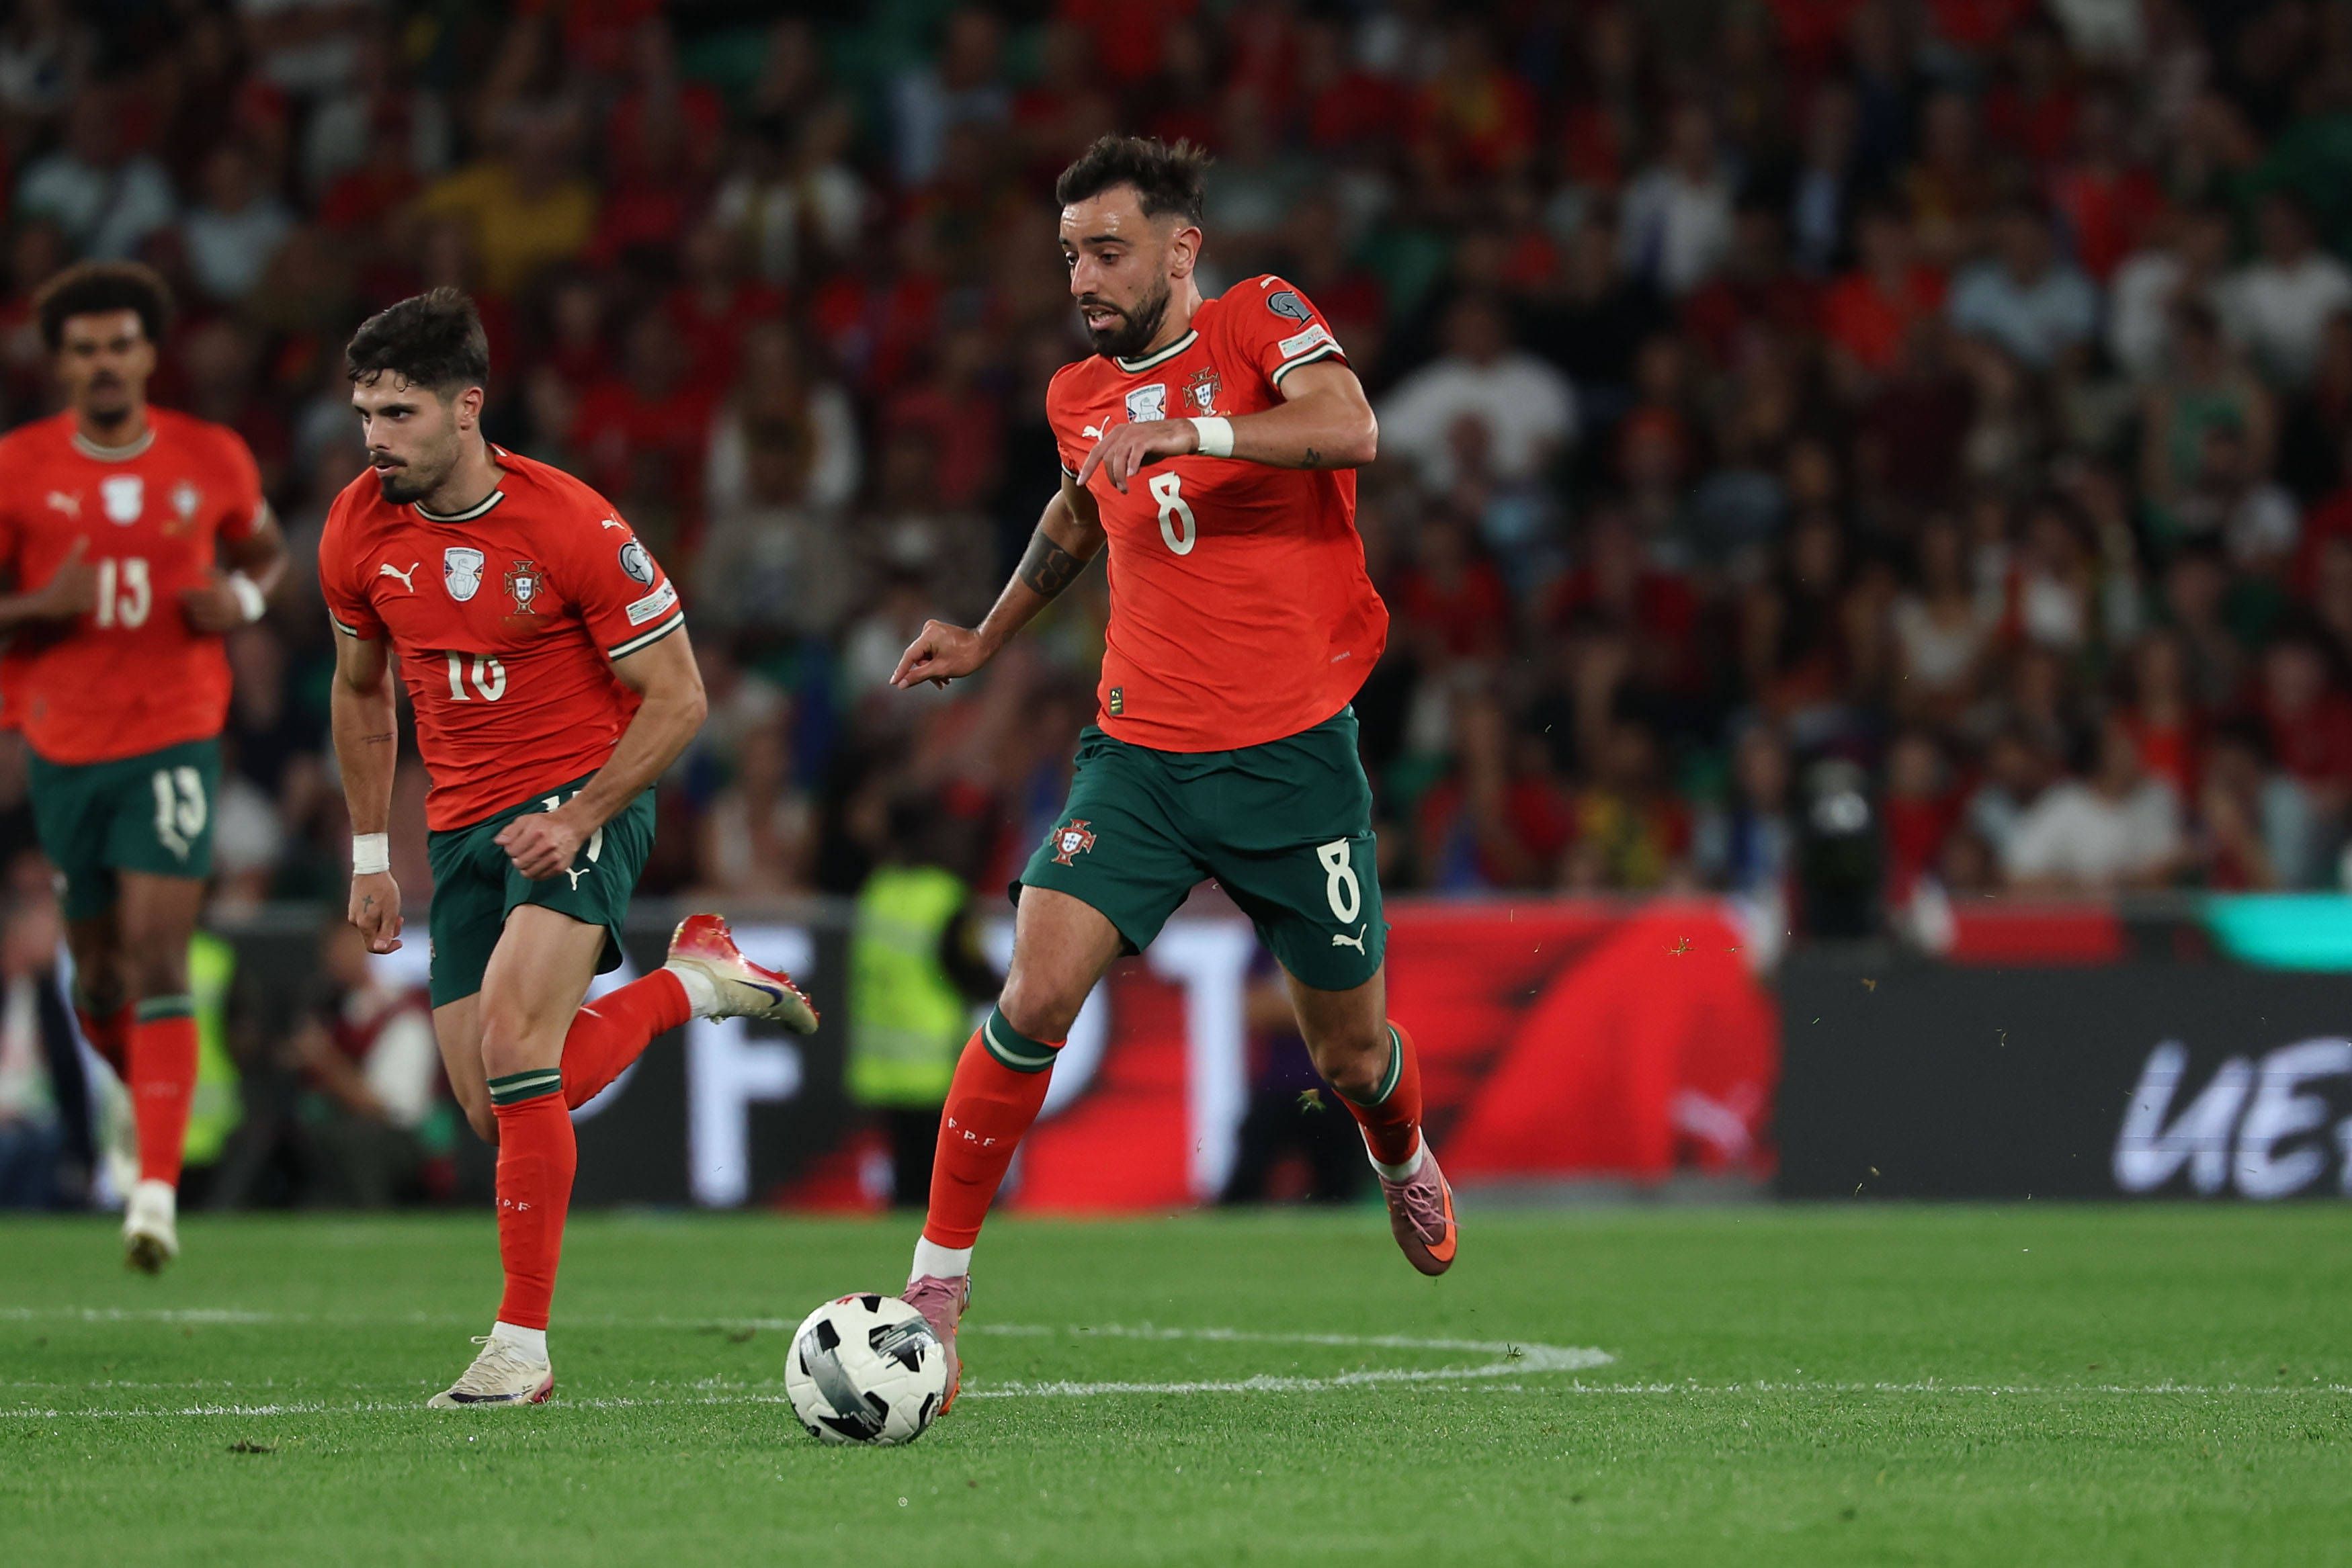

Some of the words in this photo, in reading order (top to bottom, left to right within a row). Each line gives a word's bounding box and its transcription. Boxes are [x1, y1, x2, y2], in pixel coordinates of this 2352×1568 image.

[1148, 472, 1196, 556] 8
[98, 558, 151, 628] 13
[153, 765, 206, 839] 13
[1316, 837, 1361, 924] 8
[2112, 1035, 2352, 1201] UE
